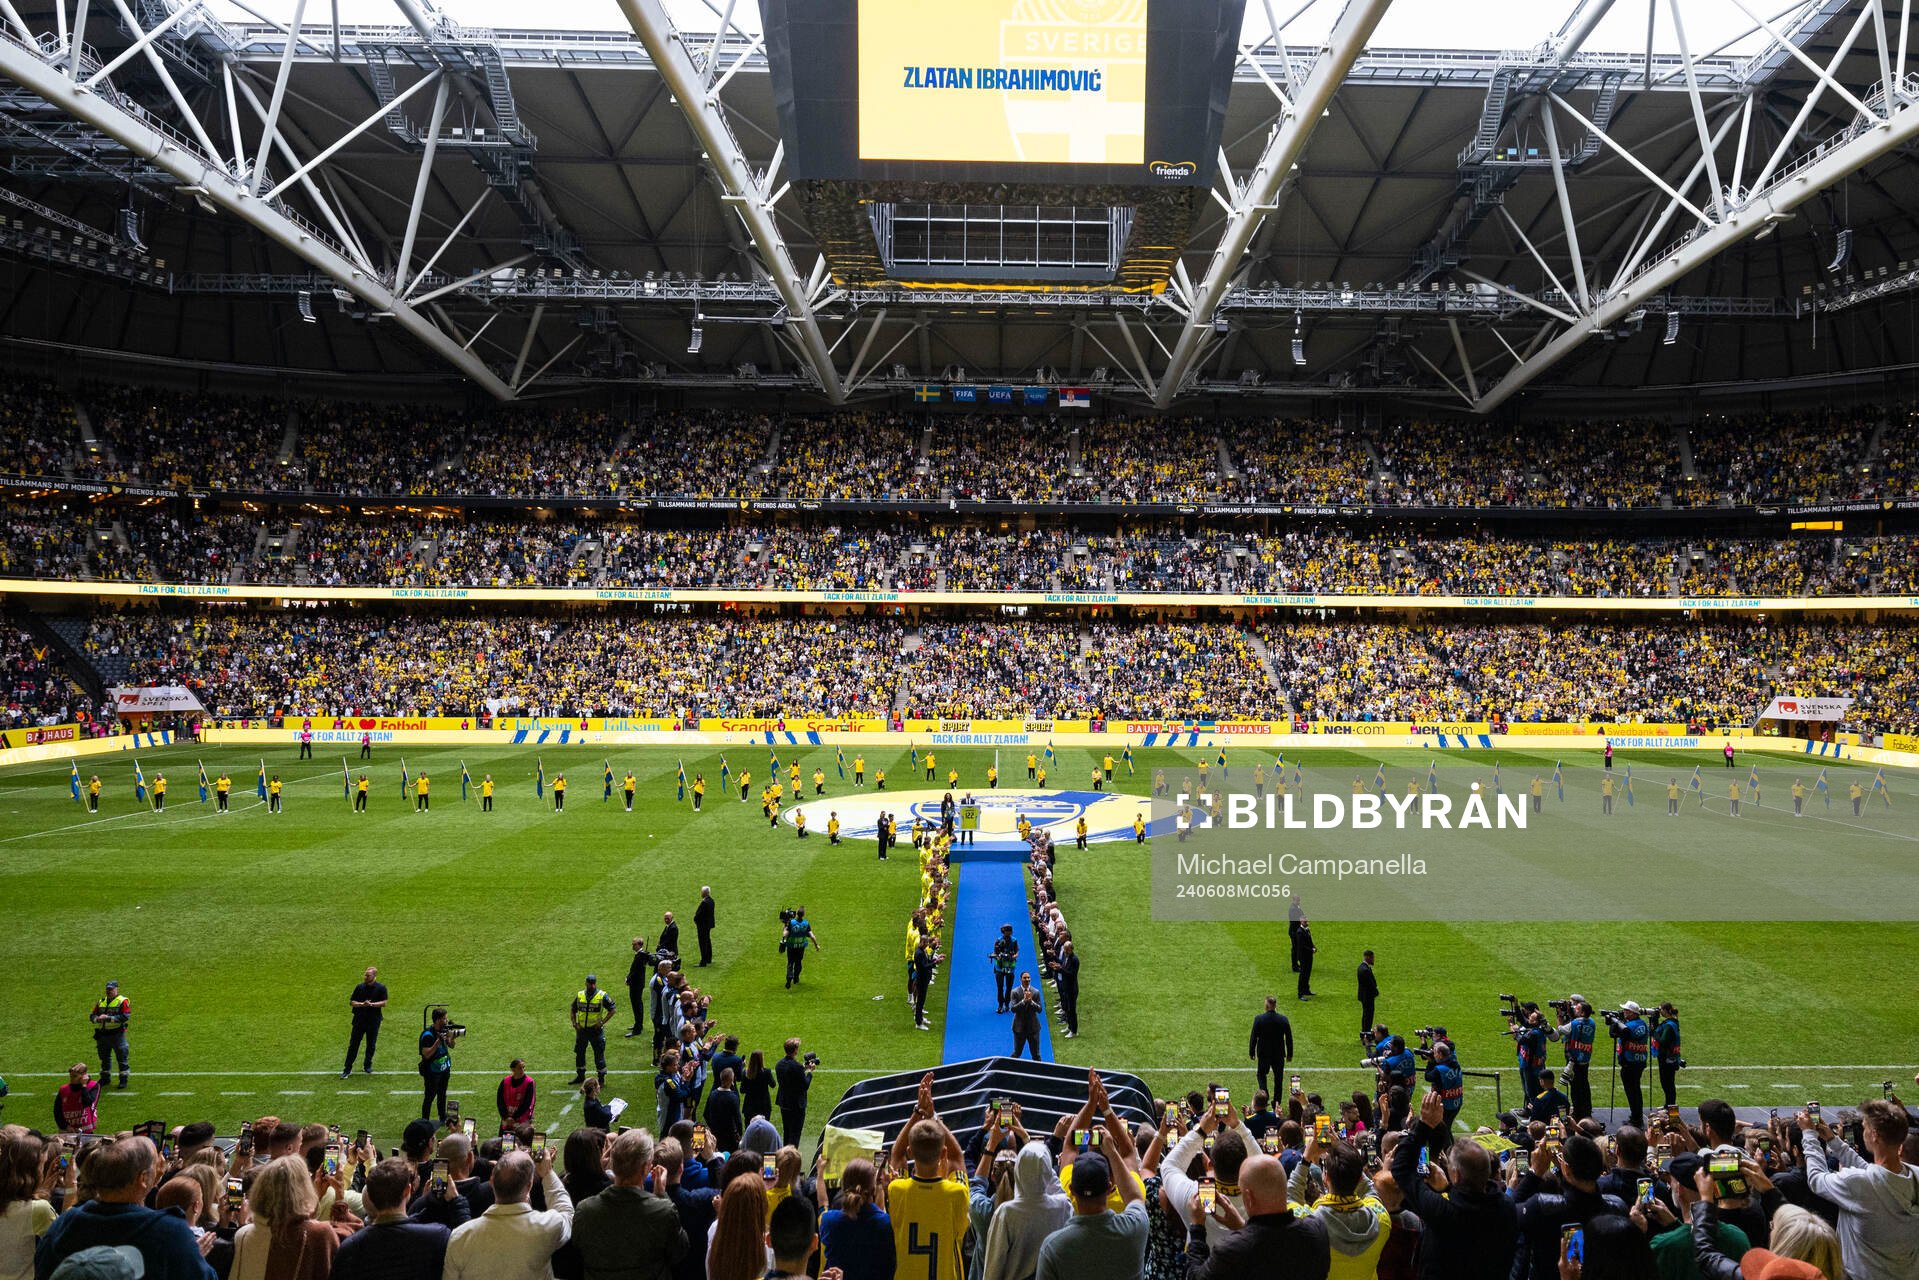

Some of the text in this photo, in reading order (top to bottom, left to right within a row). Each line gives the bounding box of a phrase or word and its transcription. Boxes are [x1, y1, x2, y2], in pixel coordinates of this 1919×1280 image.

[903, 66, 1102, 92] ZLATAN IBRAHIMOVIĆ
[1156, 165, 1189, 176] friends
[988, 391, 1011, 399] UEFA
[0, 478, 52, 488] TILLSAMMANS
[54, 482, 69, 490] MOT
[125, 488, 154, 496] FRIENDS
[155, 489, 178, 497] ARENA
[1788, 506, 1830, 514] TILLSAMMANS
[138, 586, 158, 594] TACK
[197, 587, 230, 595] ZLATAN!
[391, 589, 408, 597] TACK
[440, 590, 468, 598] ZLATAN!
[596, 591, 613, 599] TACK
[628, 591, 643, 599] ALLT
[644, 591, 672, 599] ZLATAN!
[1044, 594, 1060, 602] TACK
[1242, 596, 1258, 604] TACK
[1273, 596, 1288, 604] ALLT
[1289, 596, 1316, 604] ZLATAN!
[1493, 598, 1508, 606] ALLT
[1509, 598, 1535, 606] ZLATAN!
[1679, 599, 1697, 607] TACK
[1713, 599, 1729, 607] ALLT
[1731, 599, 1761, 607] ZLATAN!
[516, 719, 572, 731] Folksam
[604, 719, 661, 731] Folksam
[721, 721, 780, 732] Scandic
[1025, 722, 1053, 732] SPORT
[1127, 725, 1184, 733] BAUHUS
[1214, 725, 1270, 734] BAUHAUS
[1523, 727, 1571, 736] Swedbank
[1607, 727, 1655, 736] Swedbank
[293, 731, 316, 741] TAK
[335, 732, 355, 741] ALLT
[357, 732, 393, 742] ZATAN!
[932, 734, 955, 744] TACK
[973, 734, 992, 744] ALLT
[994, 734, 1029, 744] ZLATAN!
[1645, 737, 1663, 747] ALLT
[1664, 737, 1698, 747] ZLATAN!
[908, 1222, 938, 1280] 4
